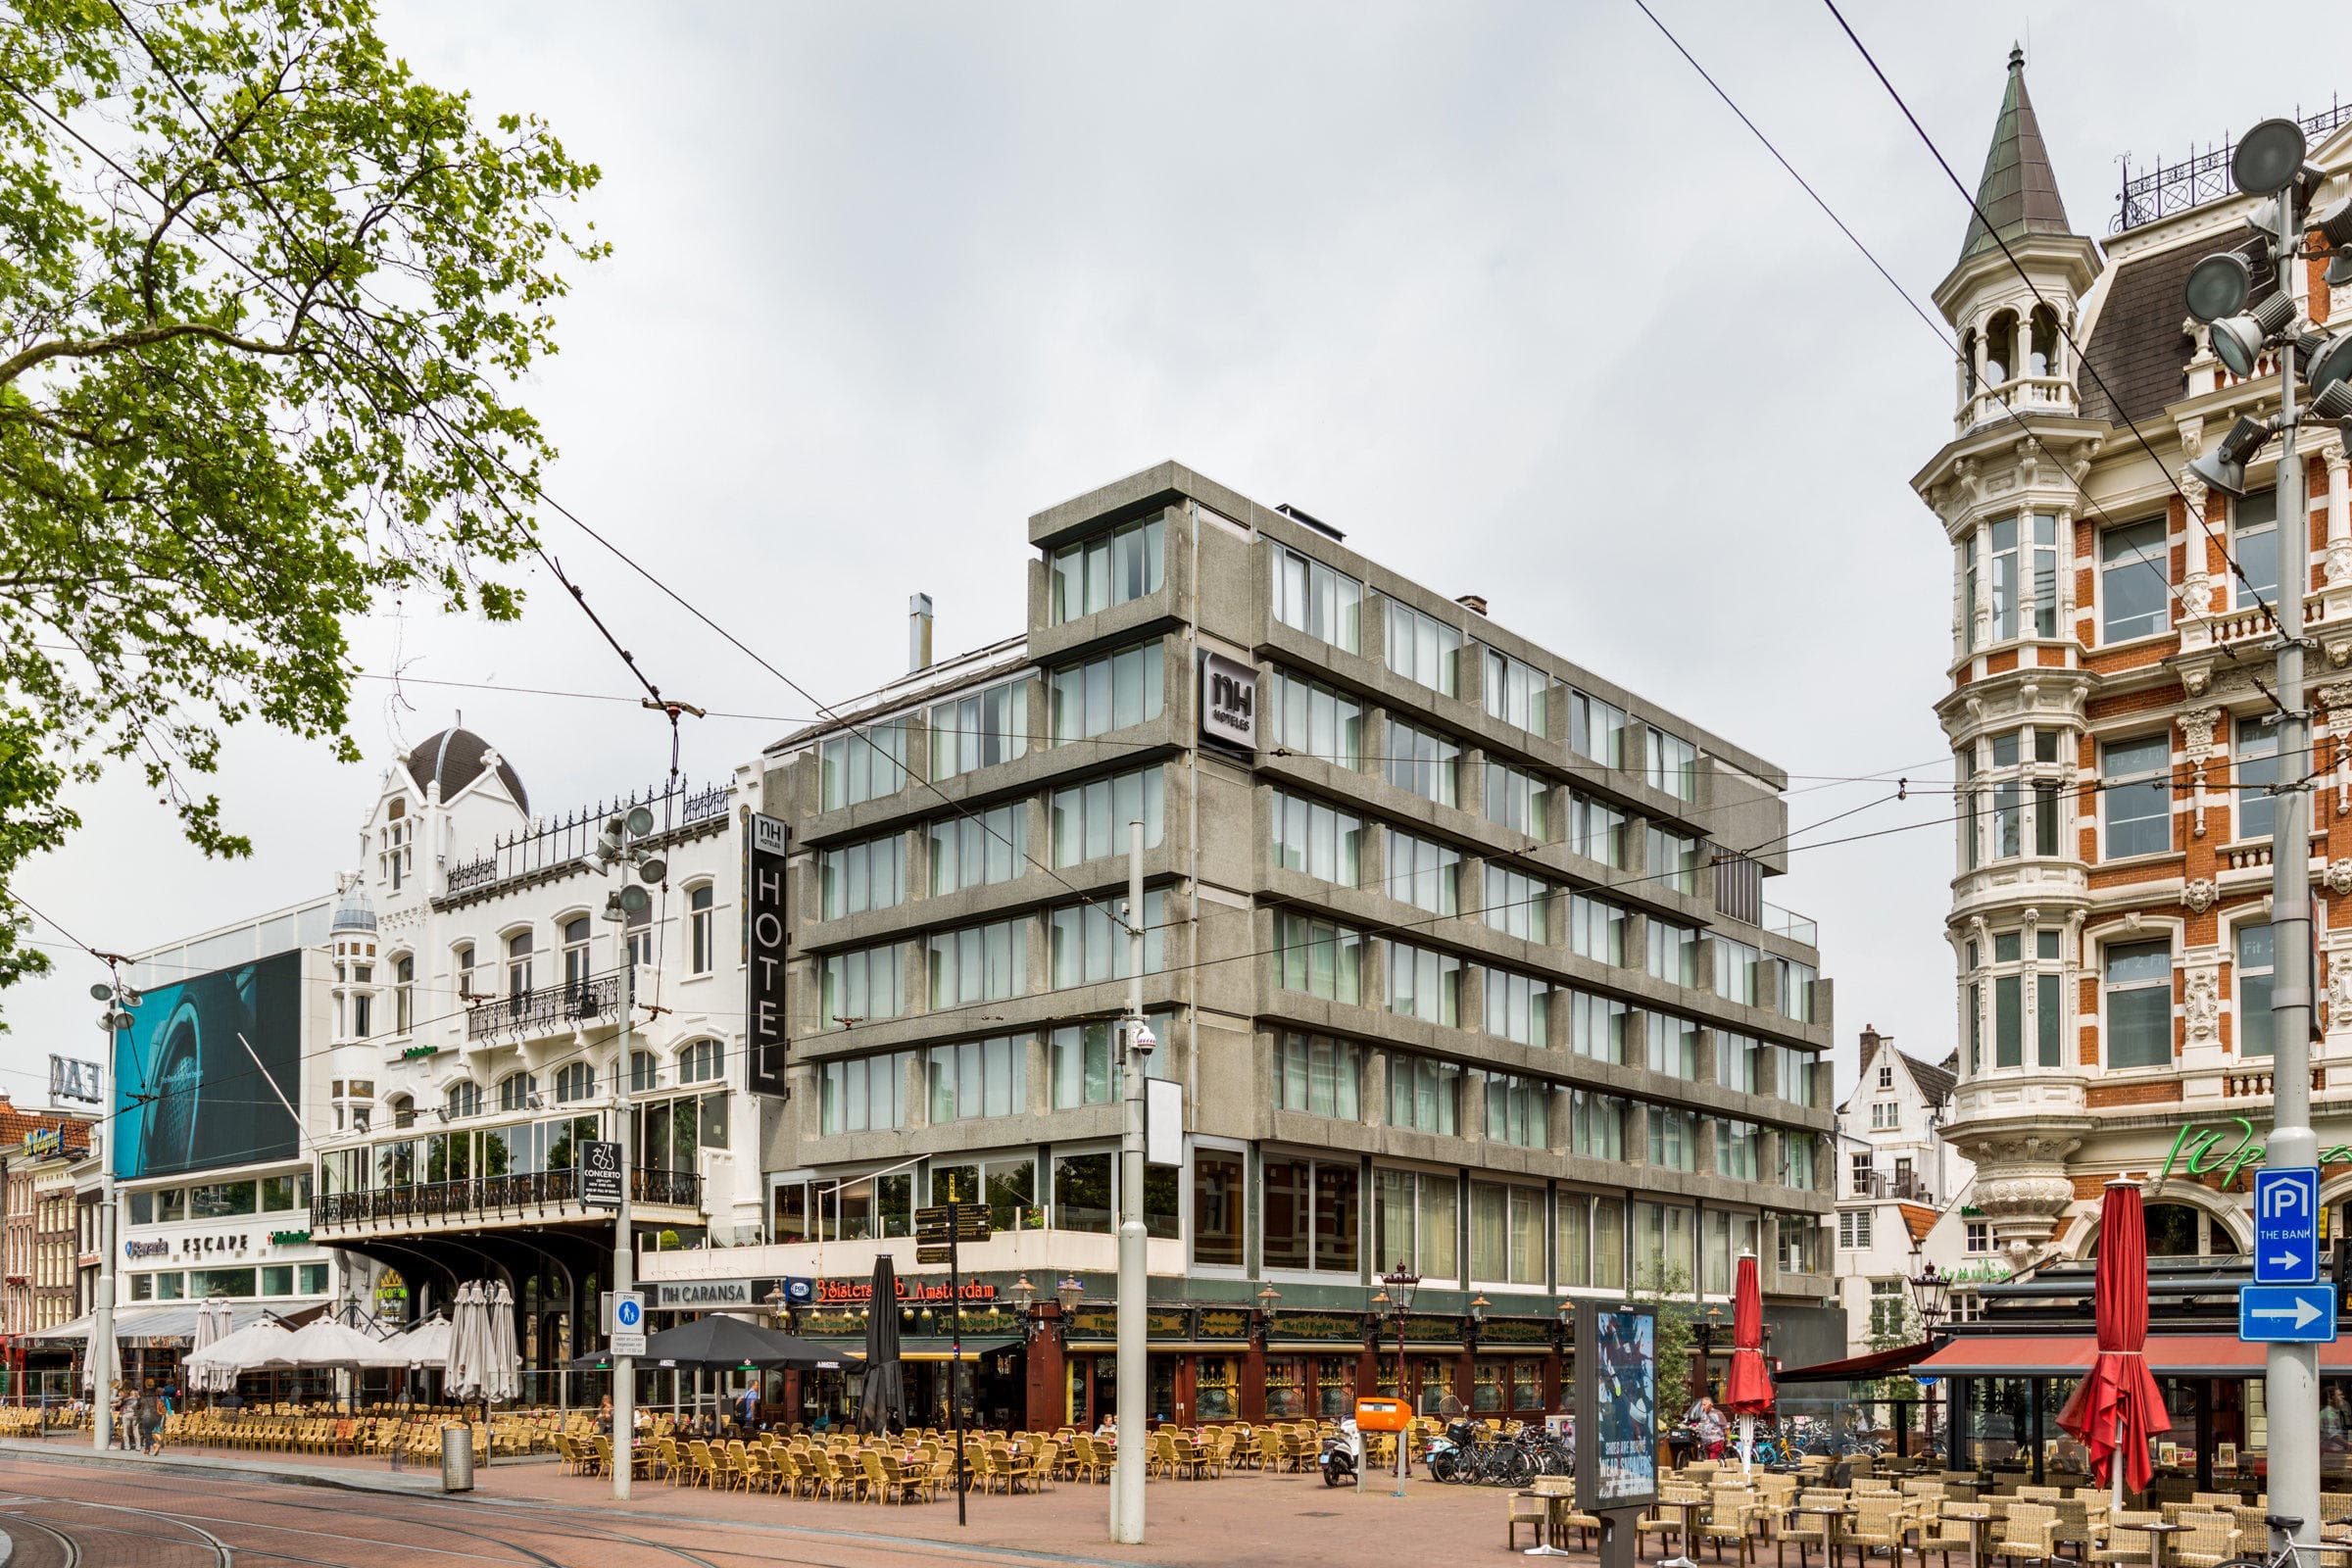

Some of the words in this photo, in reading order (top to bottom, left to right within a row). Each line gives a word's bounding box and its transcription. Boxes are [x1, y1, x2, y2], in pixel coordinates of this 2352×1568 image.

[1213, 710, 1250, 731] HOTELES
[2243, 941, 2261, 955] Fit
[756, 868, 782, 1079] HOTEL
[584, 1169, 621, 1179] CONCERTO
[272, 1230, 311, 1246] Heineke
[2260, 1231, 2279, 1240] THE
[2282, 1229, 2311, 1240] BANK
[182, 1234, 248, 1253] ESCAPE
[682, 1285, 746, 1302] CARANSA
[817, 1278, 828, 1299] 3
[828, 1280, 872, 1298] Sisters
